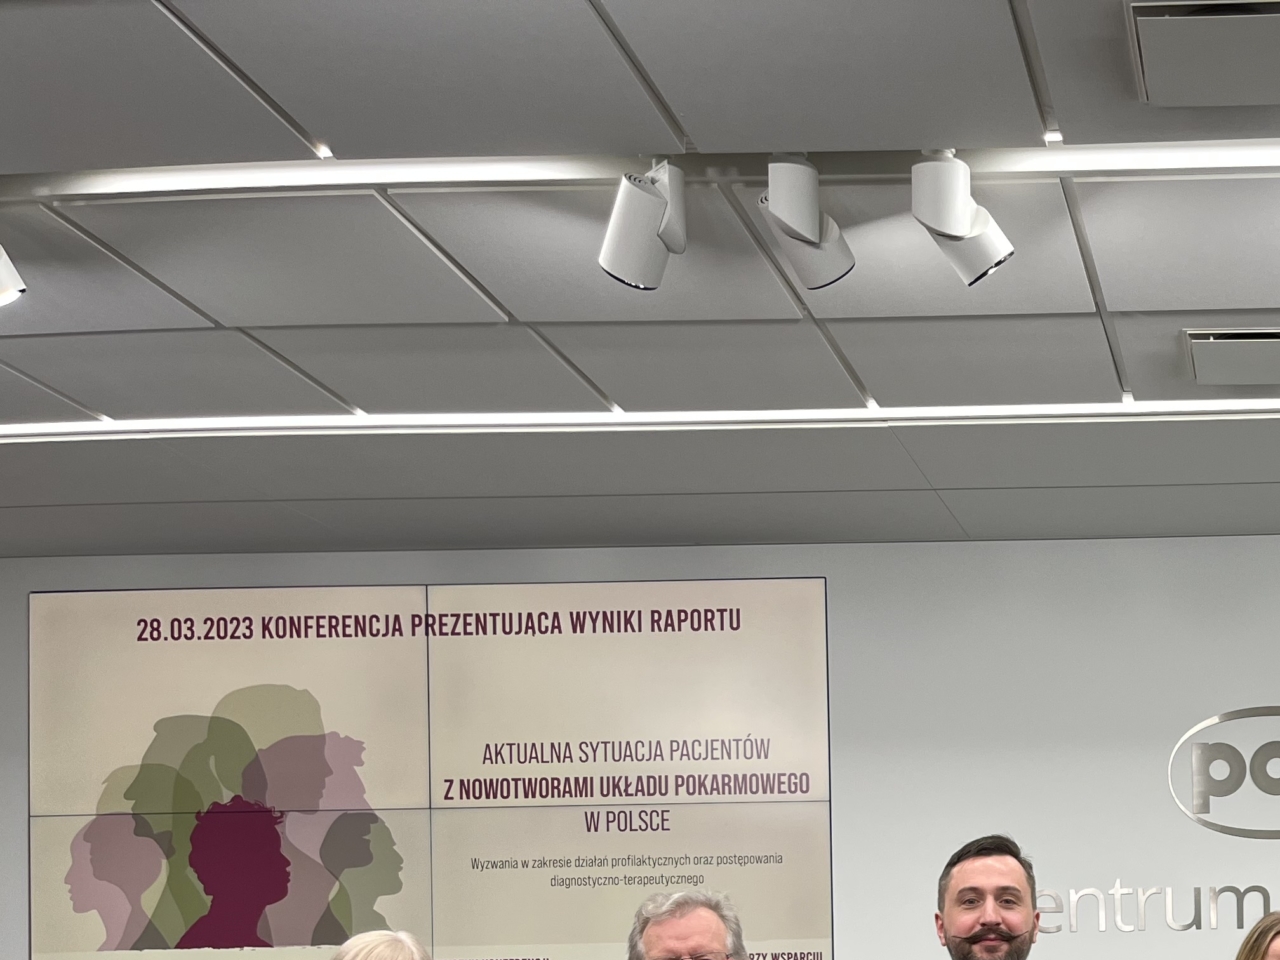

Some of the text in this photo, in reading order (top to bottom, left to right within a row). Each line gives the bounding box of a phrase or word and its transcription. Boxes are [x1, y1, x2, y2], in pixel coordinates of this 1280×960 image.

[136, 608, 741, 642] 28.03.2023 KONFERENCJA PREZENTUJĄCA WYNIKI RAPORTU
[482, 734, 770, 765] AKTUALNA SYTUACJA PACJENTÓW
[444, 772, 810, 800] Z NOWOTWORAMI UKŁADU POKARMOWEGO
[584, 809, 670, 832] W POLSCE
[470, 853, 783, 871] Wyzwania w zakresie działań profilaktycznych oraz postępowania
[550, 873, 704, 889] diagnostyczno-terapeutycznego
